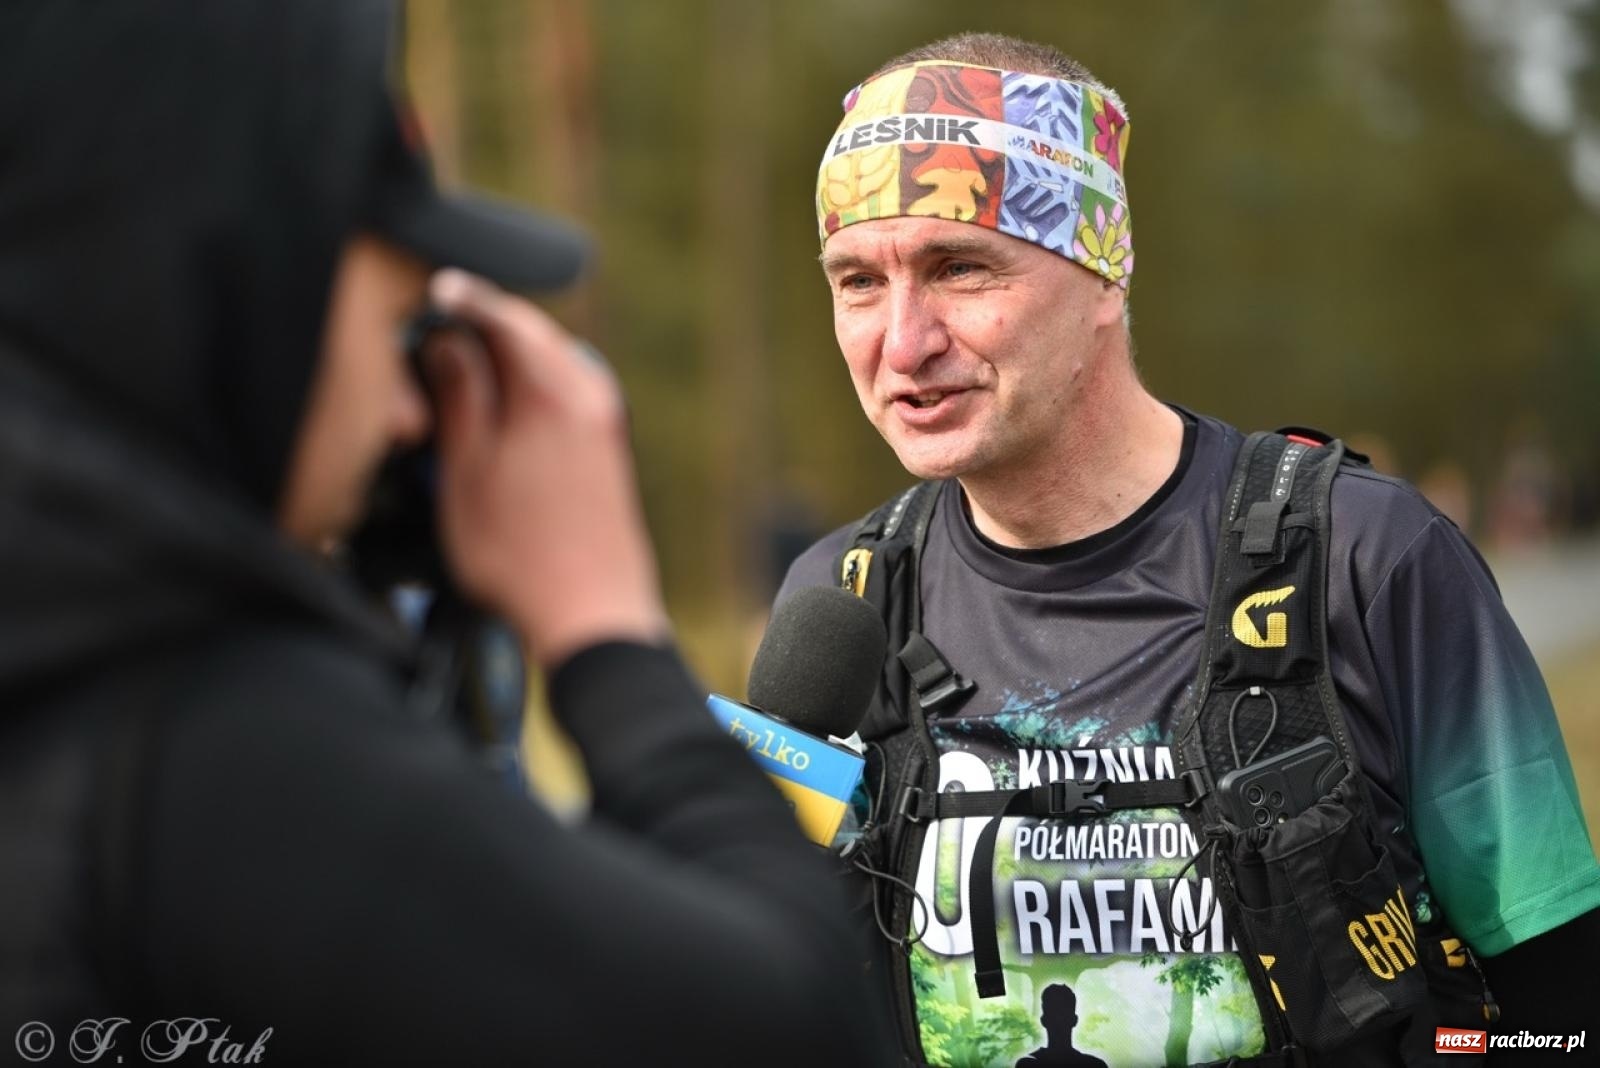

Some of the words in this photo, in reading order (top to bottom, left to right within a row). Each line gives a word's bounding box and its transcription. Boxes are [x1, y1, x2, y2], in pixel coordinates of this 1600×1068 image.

[729, 717, 811, 771] tylko
[1013, 816, 1201, 862] PÓŁMARATON
[1012, 876, 1240, 955] RAFAM
